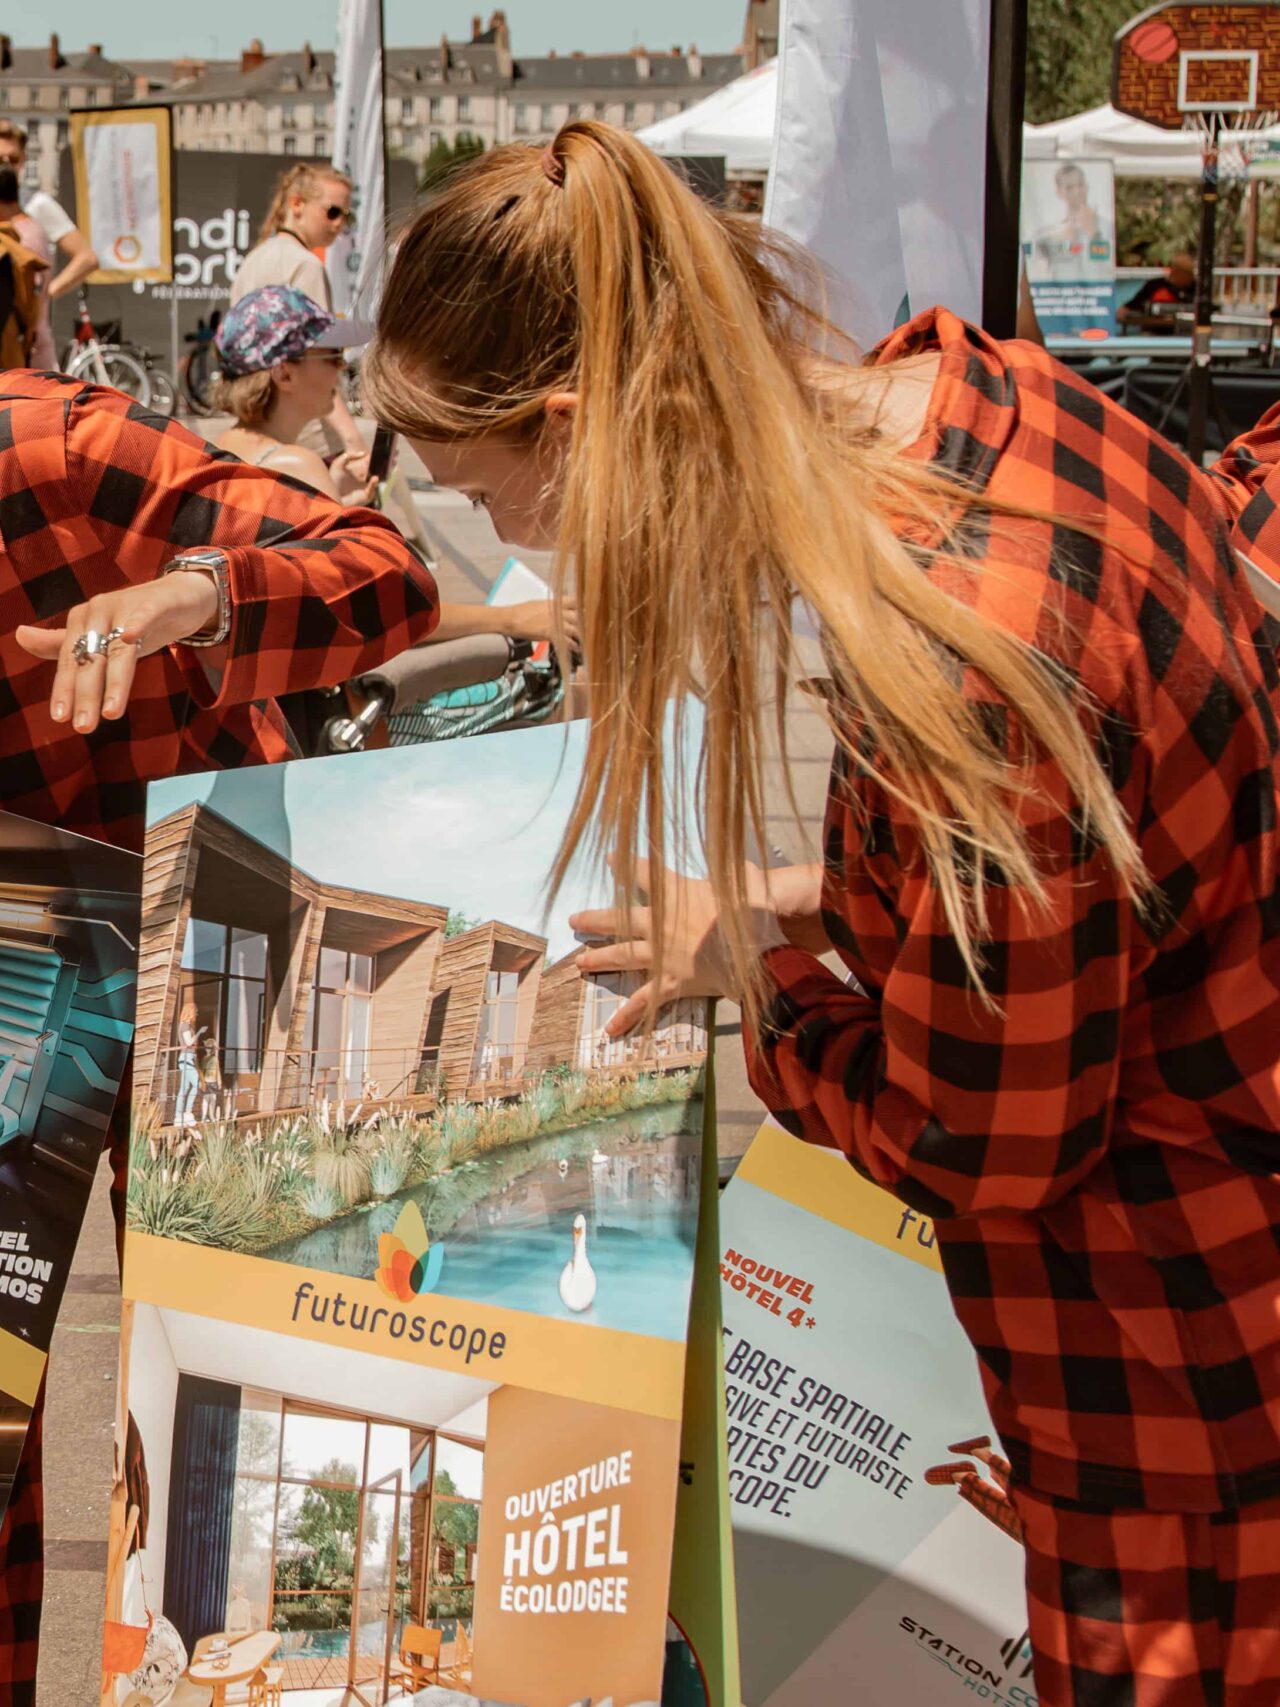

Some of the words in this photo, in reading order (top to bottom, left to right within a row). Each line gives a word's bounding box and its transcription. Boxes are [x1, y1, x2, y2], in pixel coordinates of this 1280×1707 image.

[718, 1263, 781, 1316] HÔTEL
[724, 1248, 815, 1305] NOUVEL
[291, 1282, 507, 1364] futuroscope
[724, 1339, 796, 1399] BASE
[790, 1377, 911, 1461] SPATIALE
[505, 1450, 632, 1520] OUVERTURE
[765, 1408, 799, 1439] ET
[794, 1421, 913, 1500] FUTURISTE
[784, 1453, 830, 1490] DU
[503, 1504, 628, 1577] HÔTEL
[500, 1577, 629, 1614] ÉCOLODGEE
[899, 1616, 1002, 1688] STATION
